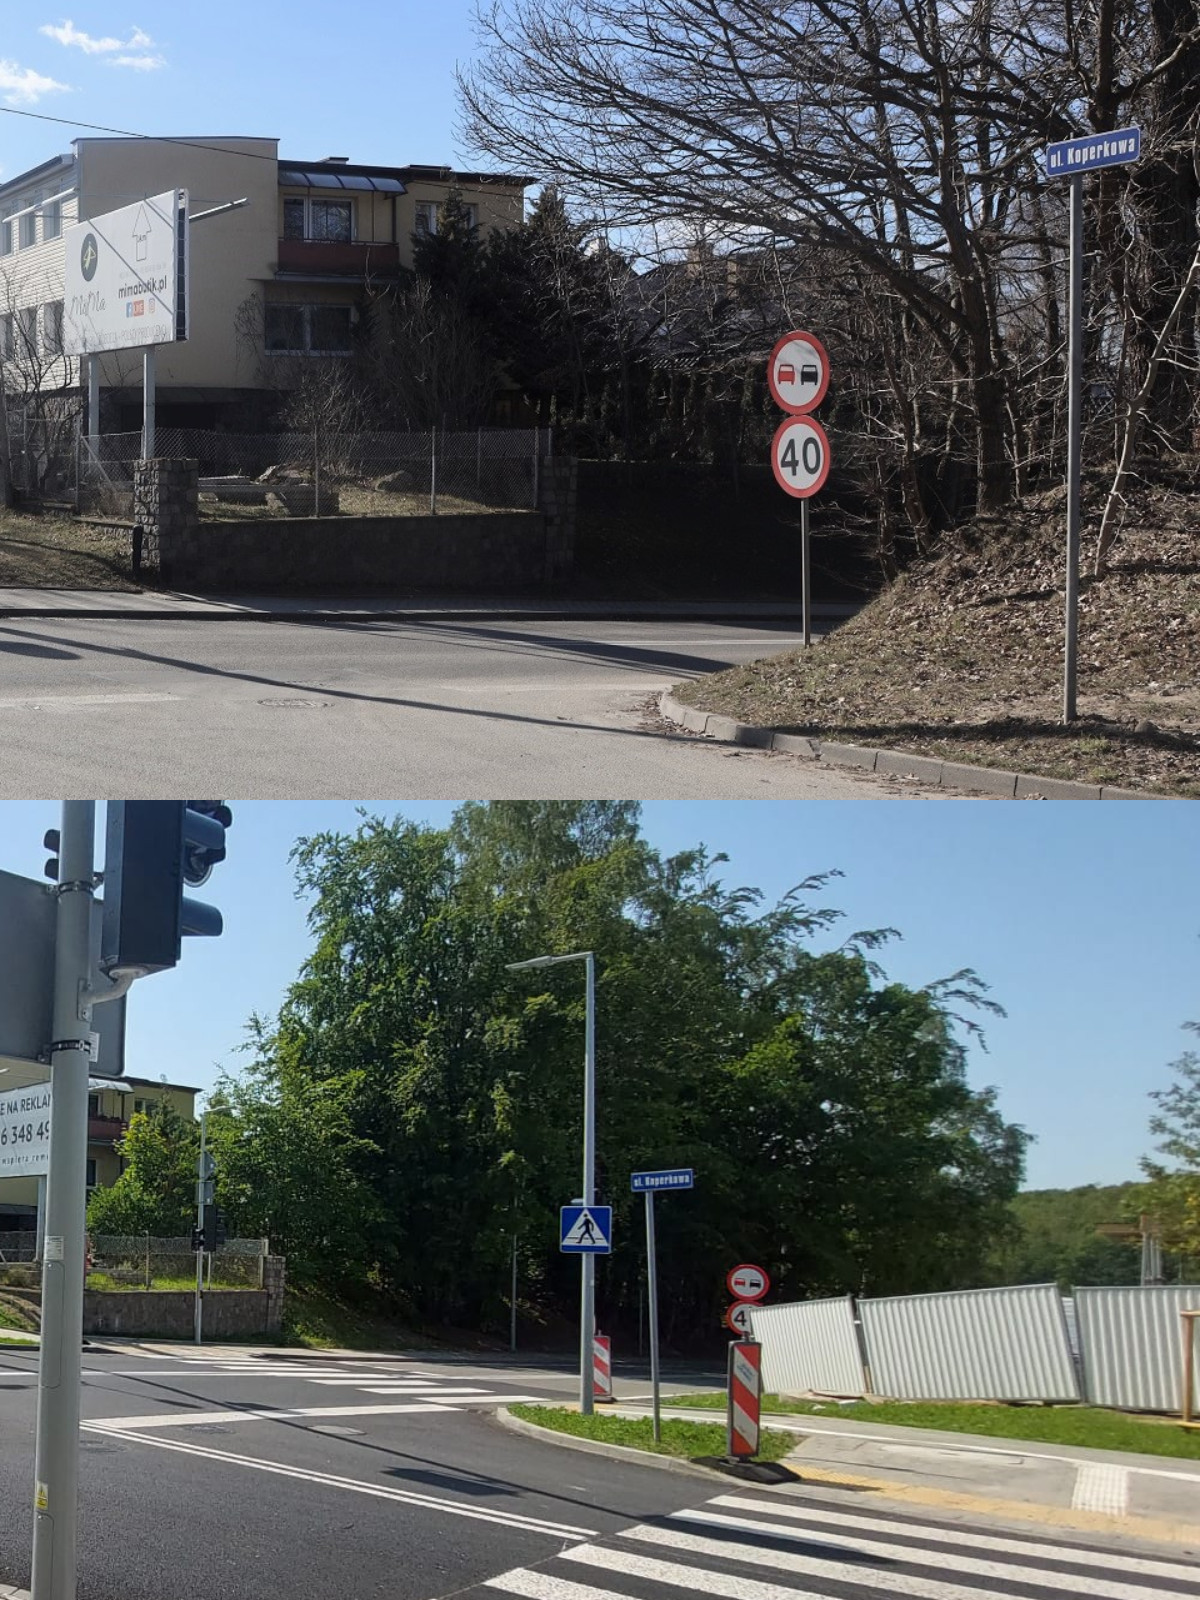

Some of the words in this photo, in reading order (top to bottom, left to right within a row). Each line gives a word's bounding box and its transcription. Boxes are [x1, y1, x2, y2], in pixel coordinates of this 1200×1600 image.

[1050, 150, 1064, 168] ul.
[1067, 138, 1135, 164] Koperkowa
[780, 437, 821, 476] 40
[6, 1100, 19, 1115] NA
[11, 1123, 33, 1145] 348
[734, 1309, 748, 1326] 4
